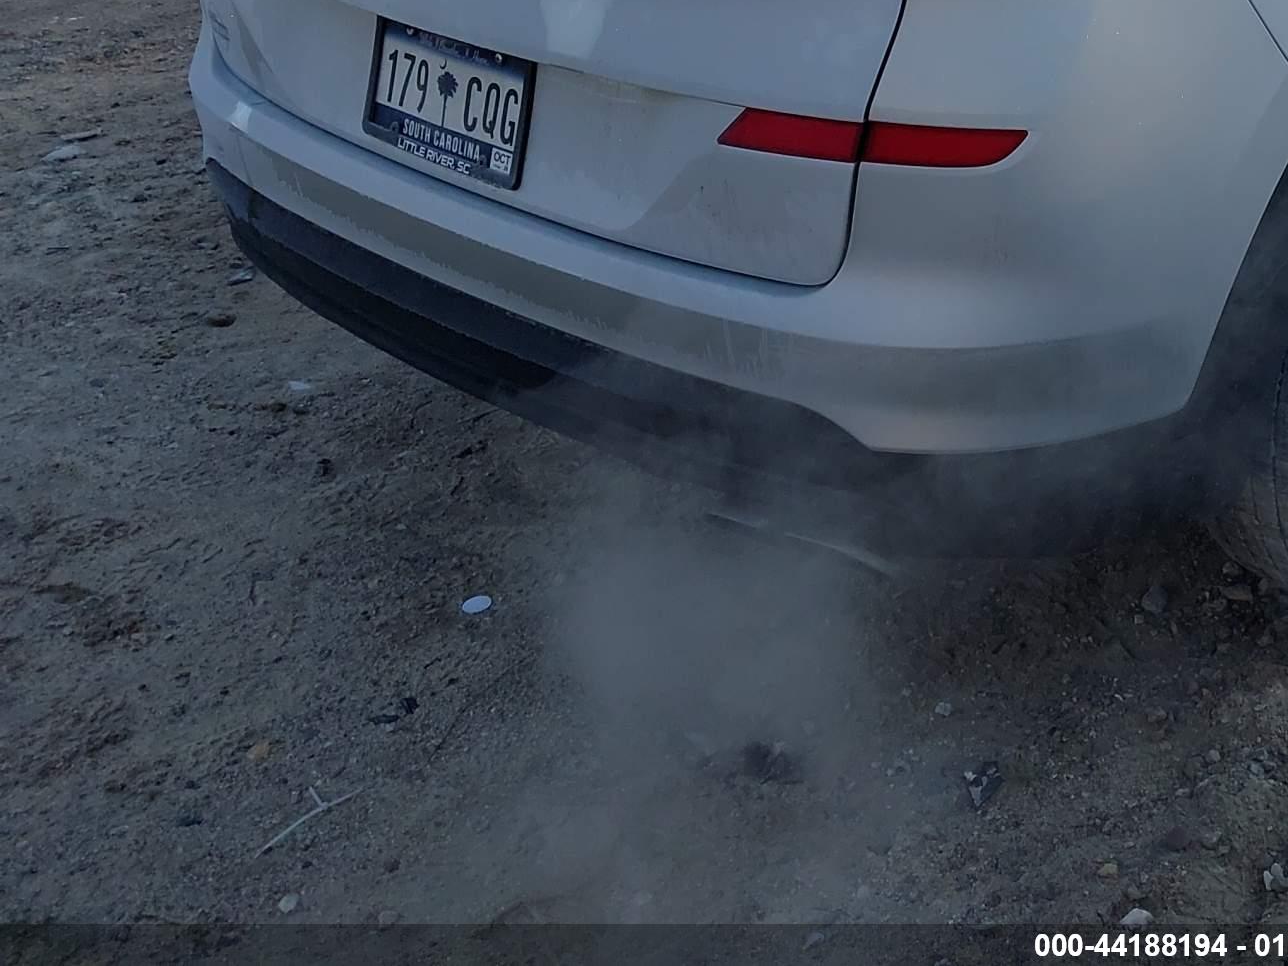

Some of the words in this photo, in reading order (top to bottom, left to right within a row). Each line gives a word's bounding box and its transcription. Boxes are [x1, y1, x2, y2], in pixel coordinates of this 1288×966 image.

[387, 49, 429, 114] 179
[463, 76, 519, 146] CQG
[397, 137, 426, 158] LITTLE
[456, 161, 472, 175] SC
[402, 118, 431, 143] SOUTH
[433, 129, 480, 162] CAROLINA
[493, 150, 512, 166] OCT
